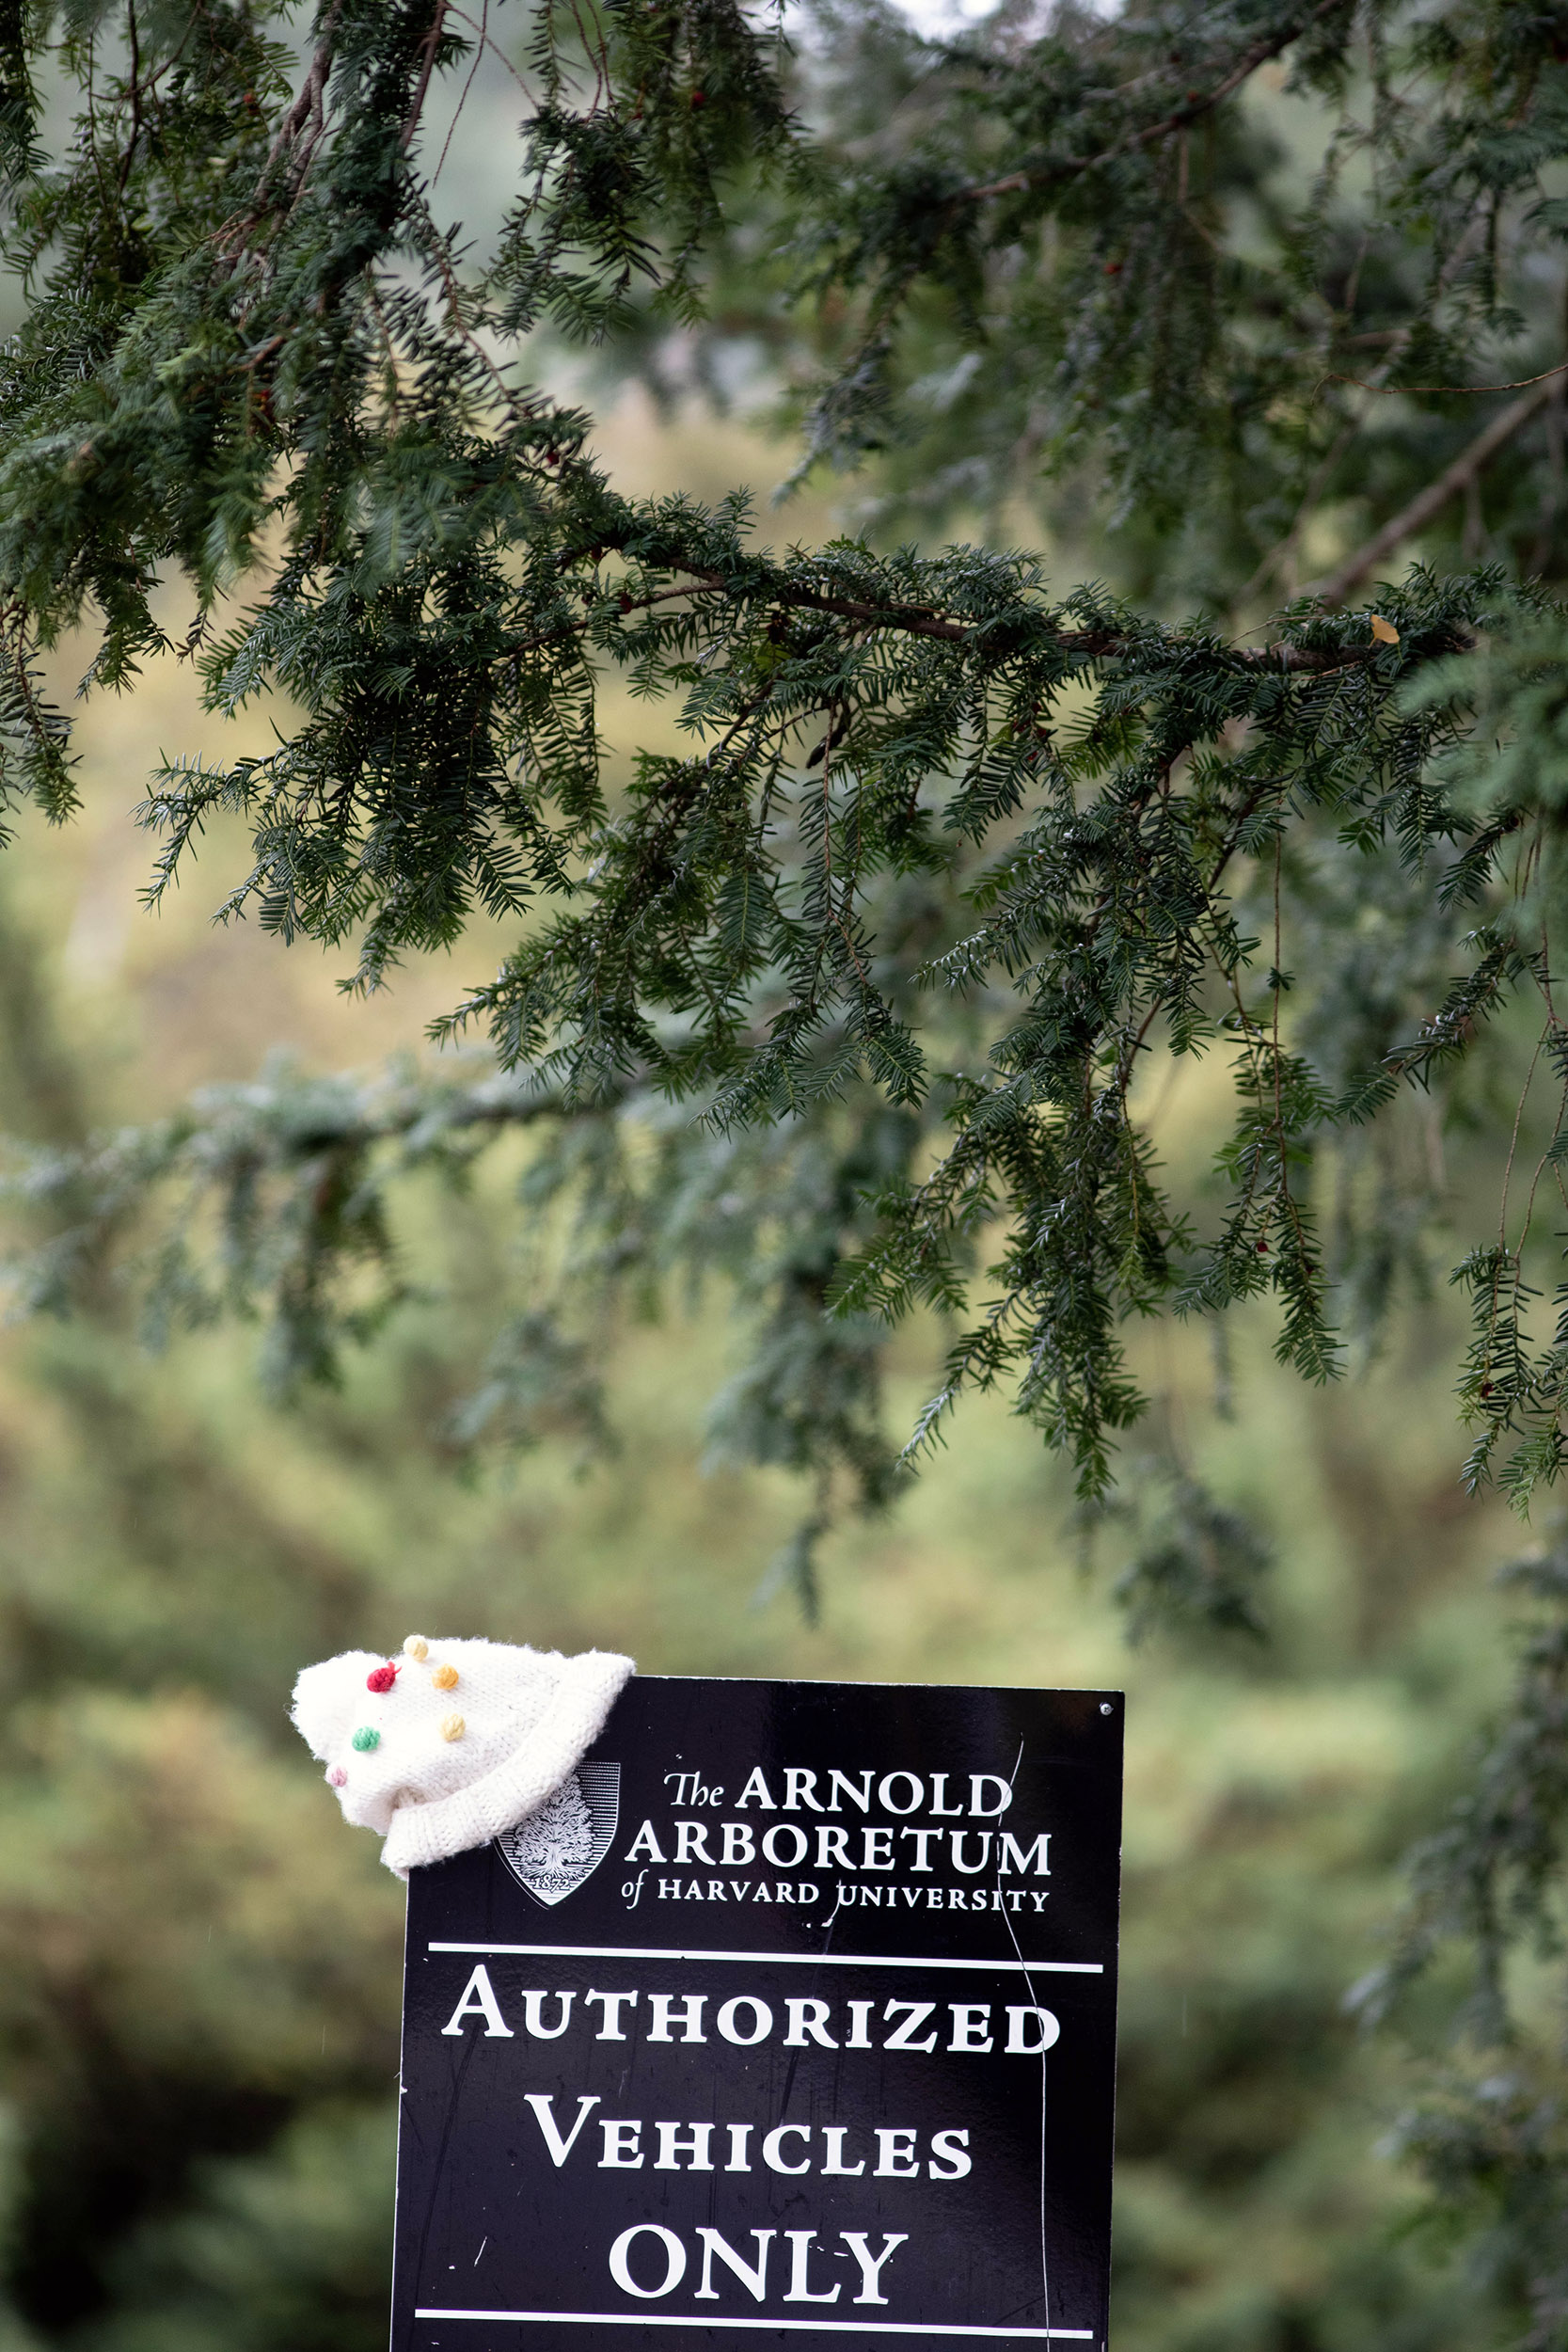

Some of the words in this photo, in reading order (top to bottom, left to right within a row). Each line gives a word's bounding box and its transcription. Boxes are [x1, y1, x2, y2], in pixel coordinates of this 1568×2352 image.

[663, 1771, 724, 1808] The
[735, 1766, 1013, 1818] ARNOLD
[625, 1820, 1053, 1876] ARBORETUM
[533, 1874, 570, 1894] 1872
[621, 1868, 649, 1910] of
[657, 1879, 819, 1904] HARVARD
[838, 1883, 1050, 1913] UNIVERSITY
[441, 1963, 1062, 2054] AUTHORIZED
[524, 2094, 973, 2181] VEHICLES
[610, 2224, 910, 2305] ONLY
